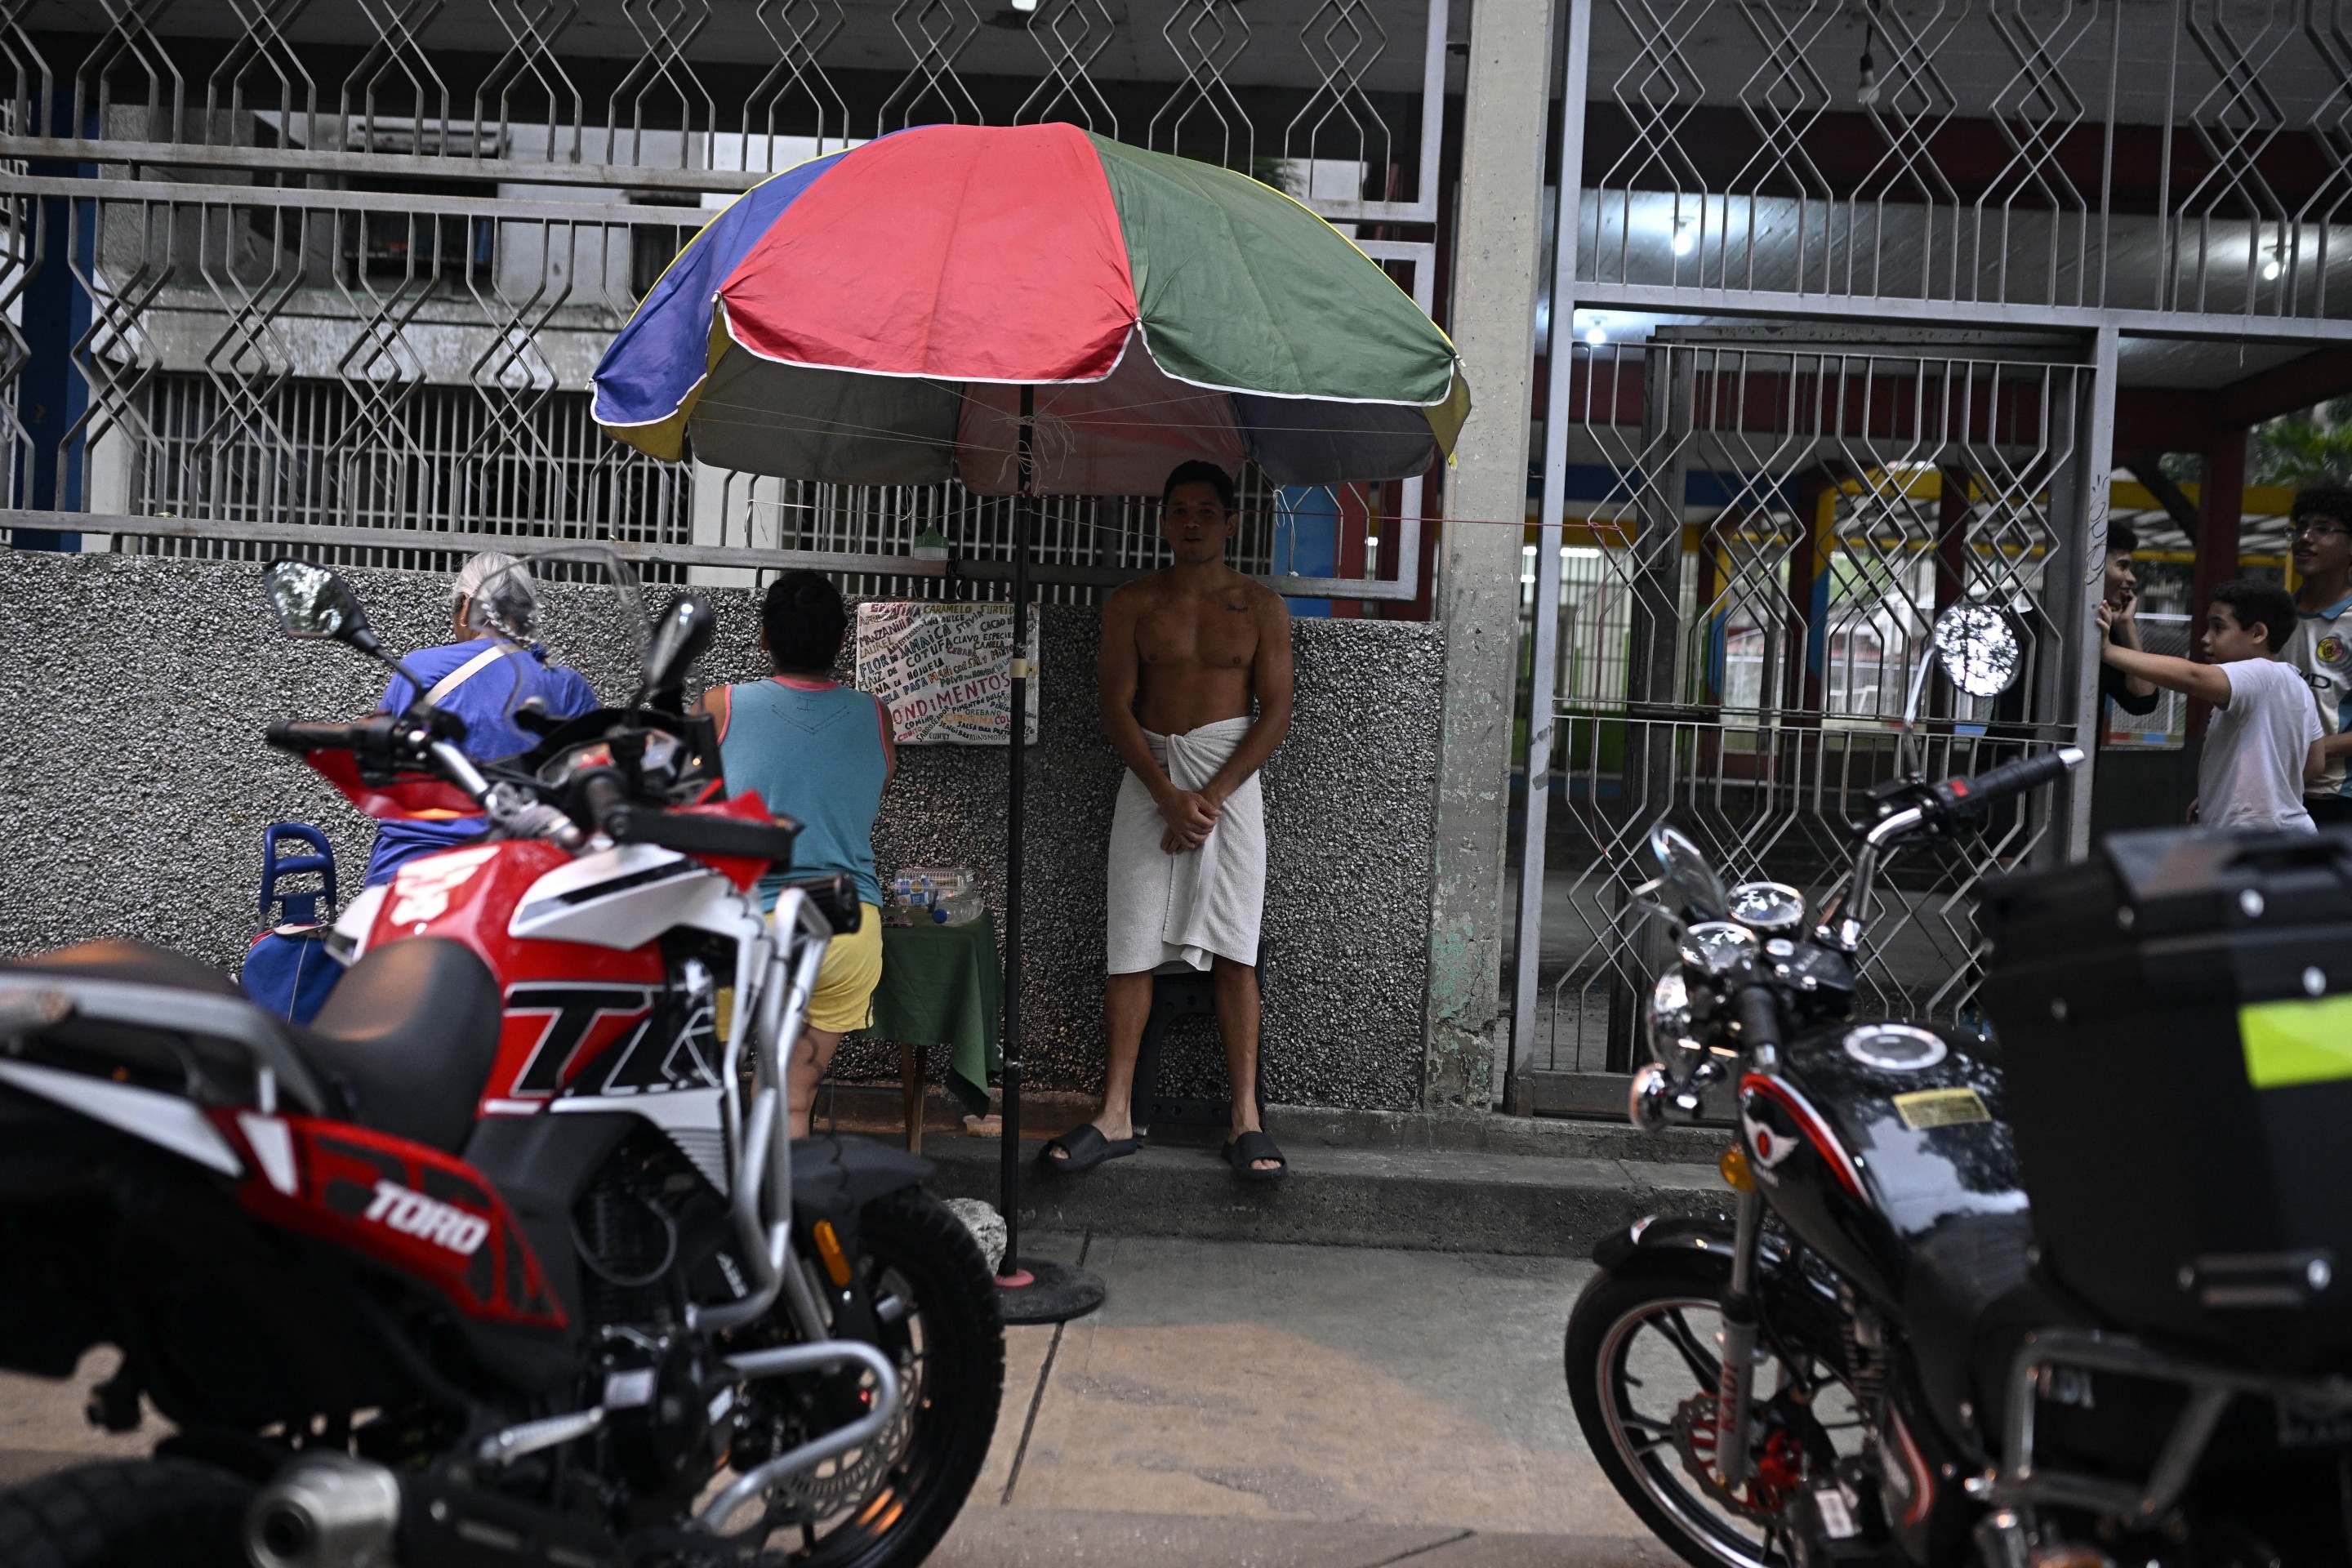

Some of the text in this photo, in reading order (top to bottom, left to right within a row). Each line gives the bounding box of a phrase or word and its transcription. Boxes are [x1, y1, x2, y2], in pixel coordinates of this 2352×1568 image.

[924, 604, 973, 614] CARAMELO
[980, 604, 1014, 615] SURTiD
[980, 618, 1005, 632] CACAO
[953, 635, 978, 644] CLAVO
[906, 638, 953, 668] COTUFA
[906, 657, 944, 680] HOJUELA
[893, 671, 1011, 725] ONDIMENTOS
[993, 727, 1013, 736] PAST
[365, 1178, 491, 1257] TORO
